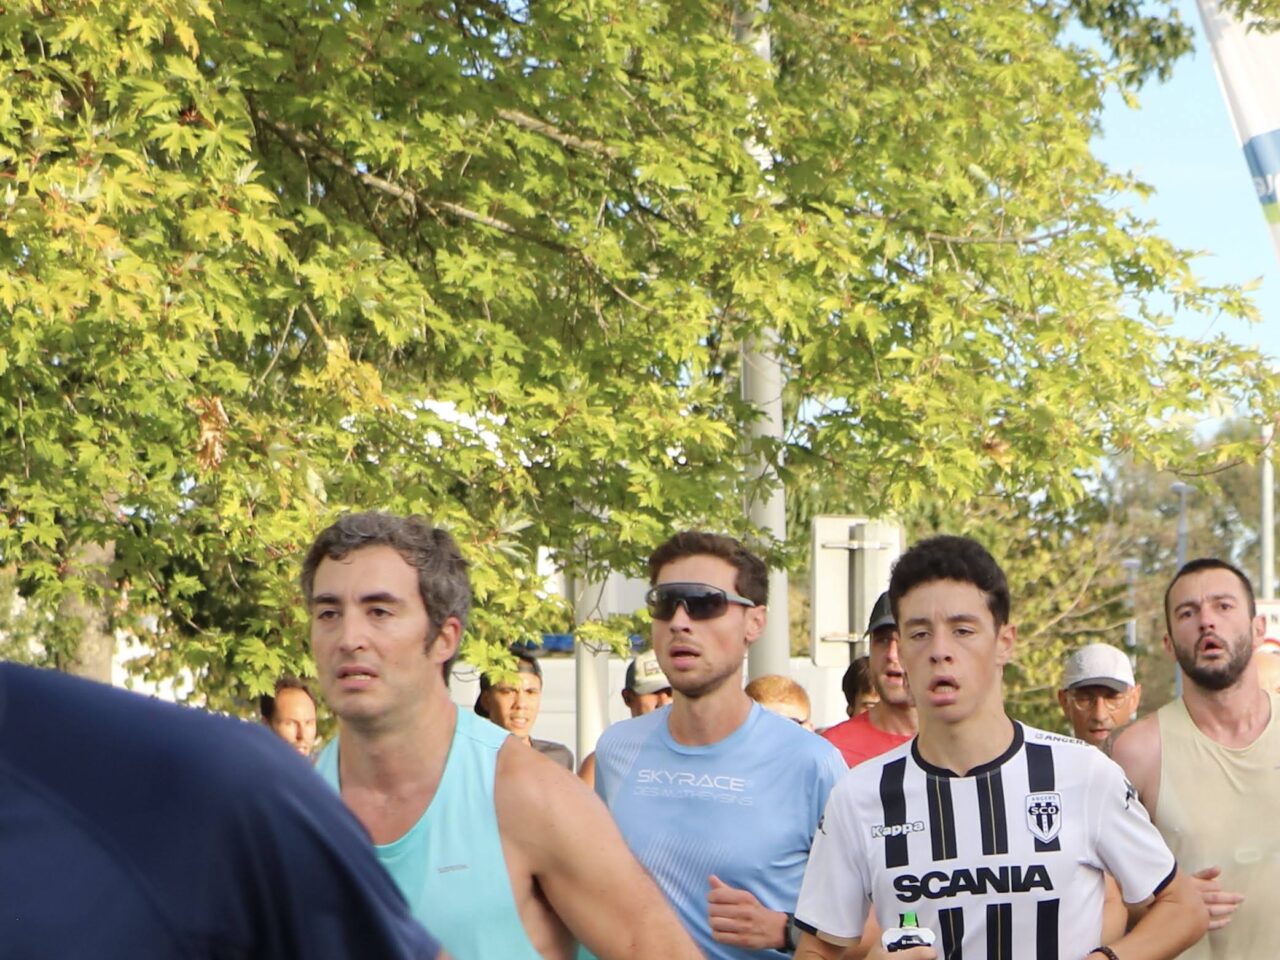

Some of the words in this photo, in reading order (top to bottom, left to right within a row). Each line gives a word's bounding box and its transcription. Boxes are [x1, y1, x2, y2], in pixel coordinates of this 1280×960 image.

[637, 768, 746, 792] SKYRACE
[1030, 806, 1057, 815] SCO
[871, 820, 925, 838] Kappa
[893, 864, 1055, 904] SCANIA
